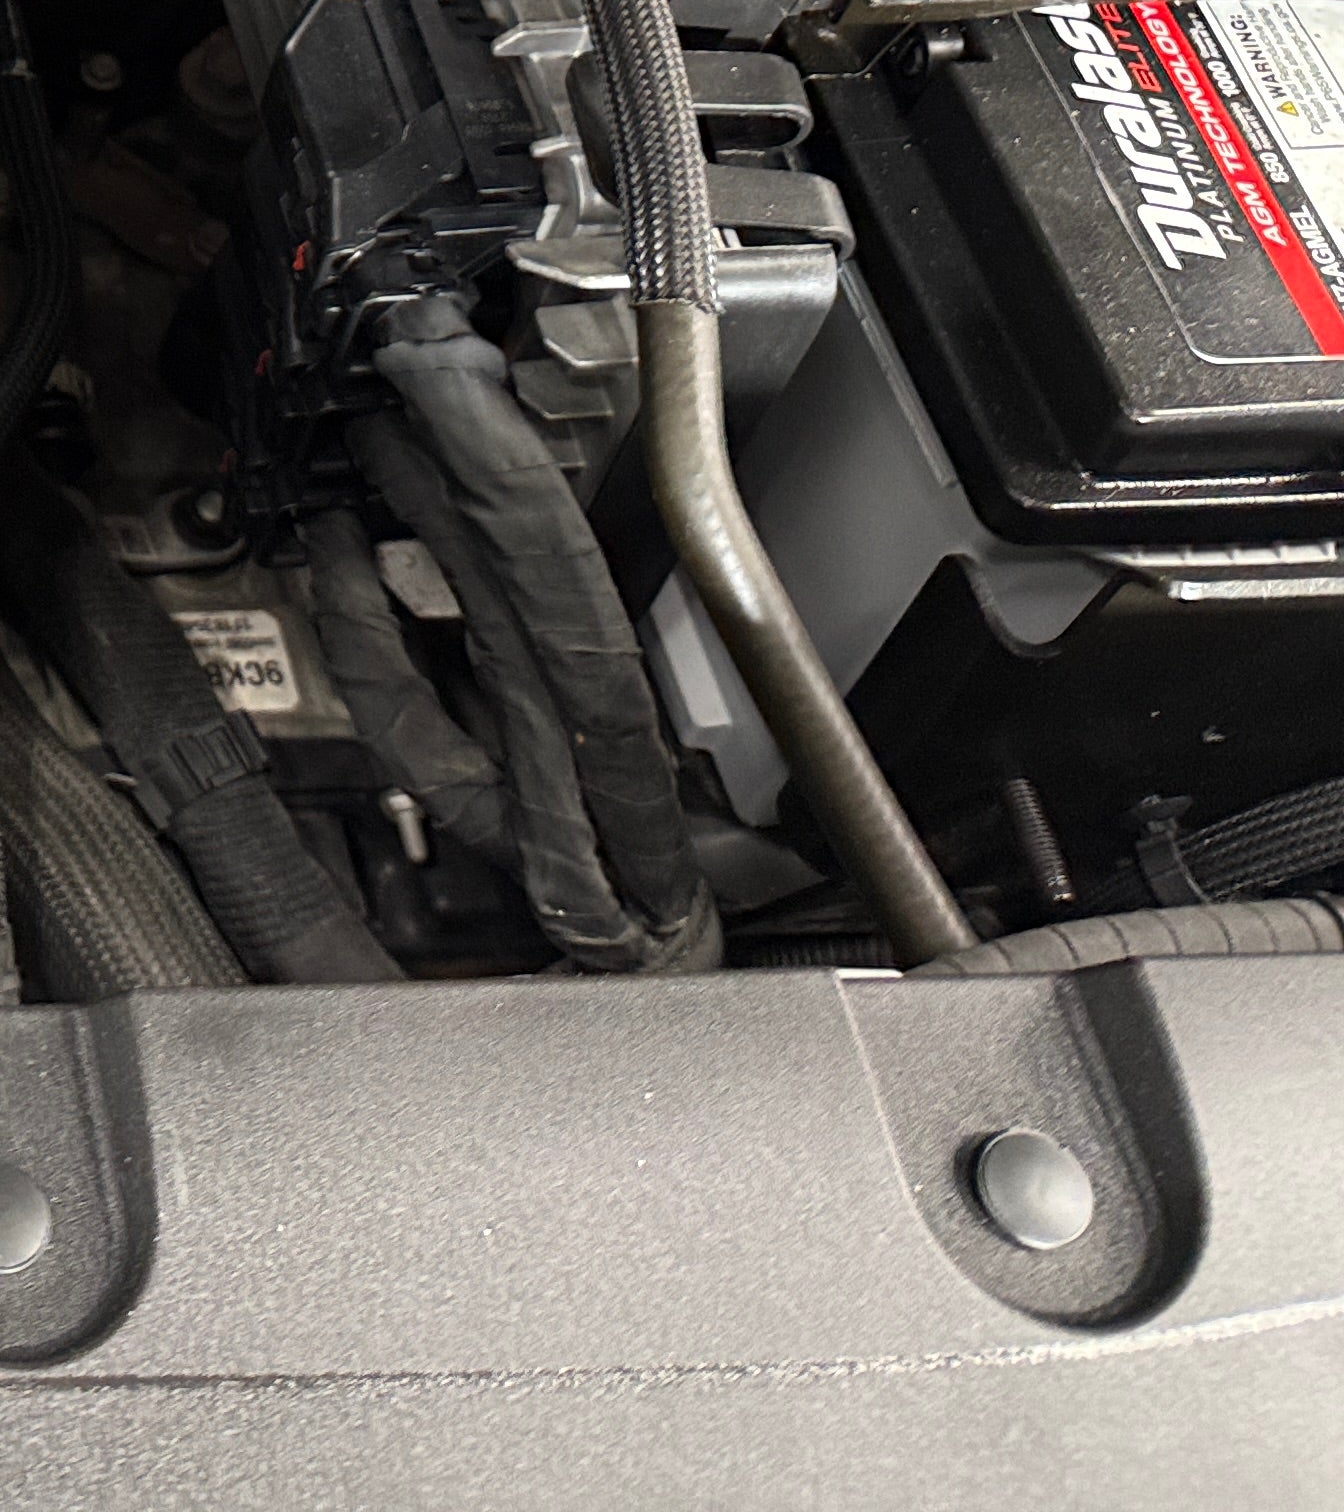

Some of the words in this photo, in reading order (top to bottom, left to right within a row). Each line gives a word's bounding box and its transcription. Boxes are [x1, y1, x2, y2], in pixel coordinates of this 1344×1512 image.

[1096, 3, 1161, 92] ELITE
[1137, 3, 1245, 174] TECHNOLOGY
[1206, 61, 1241, 96] 1000
[1230, 14, 1287, 98] WARNING:
[1149, 99, 1245, 240] PLATINUM
[1258, 152, 1289, 182] 850
[1237, 183, 1285, 245] AGM
